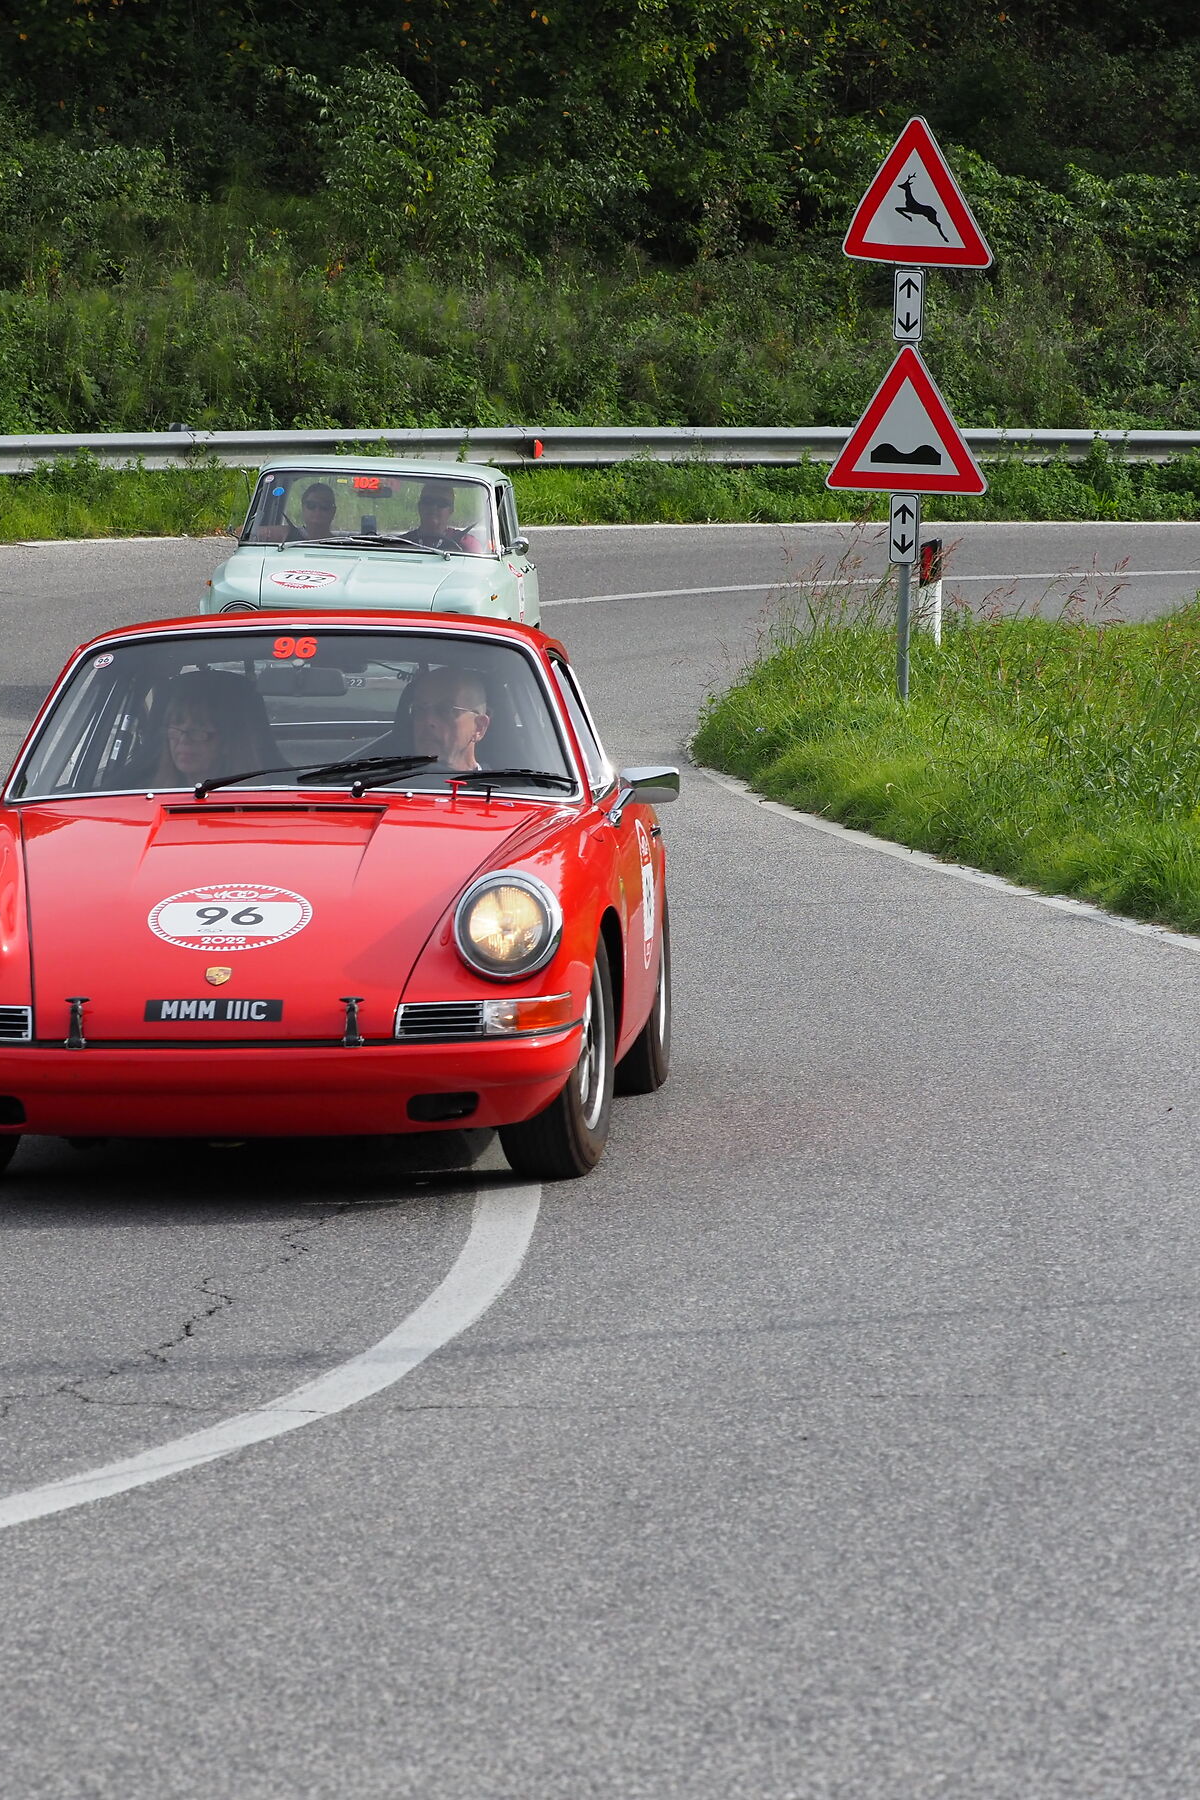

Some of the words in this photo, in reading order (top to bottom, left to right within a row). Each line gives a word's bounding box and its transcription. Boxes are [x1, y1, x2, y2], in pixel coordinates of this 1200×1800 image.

[353, 476, 380, 489] 102
[284, 574, 326, 584] 102
[272, 636, 319, 659] 96
[196, 906, 264, 926] 96
[201, 936, 246, 945] 2022
[160, 1000, 216, 1019] MMM
